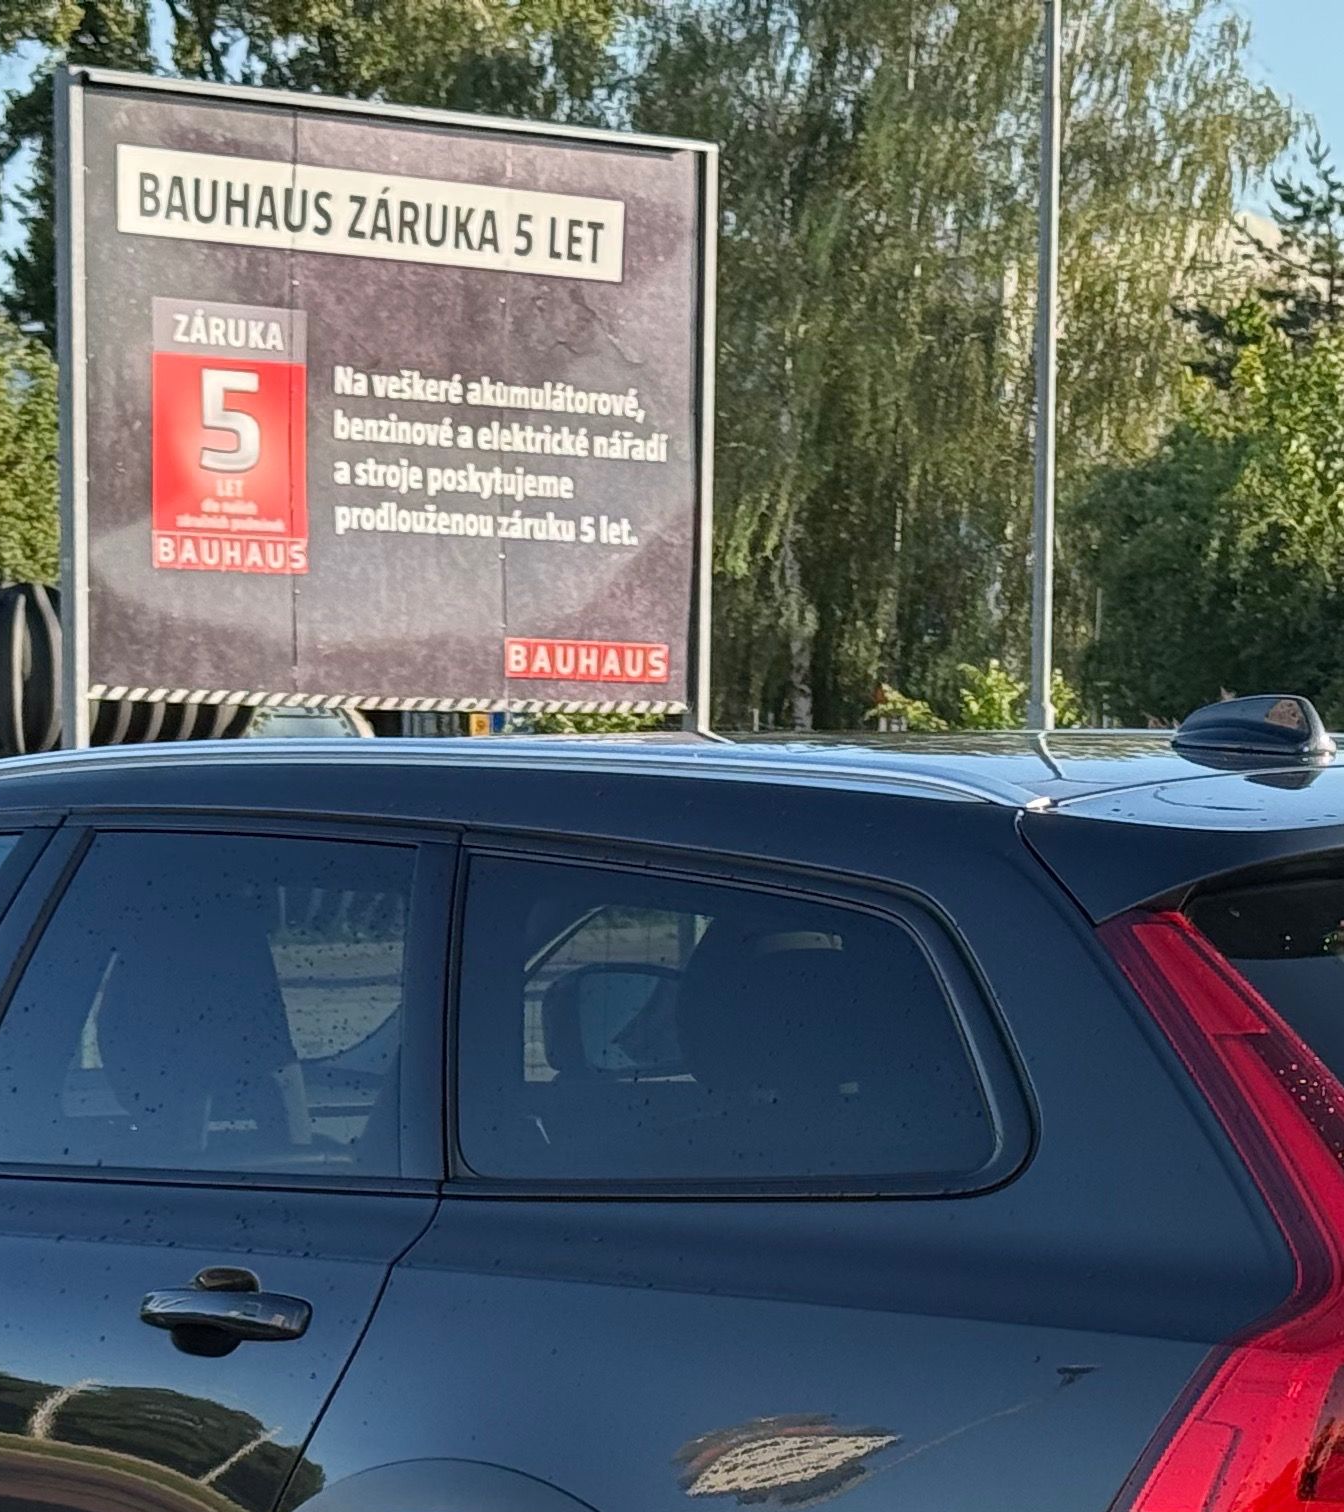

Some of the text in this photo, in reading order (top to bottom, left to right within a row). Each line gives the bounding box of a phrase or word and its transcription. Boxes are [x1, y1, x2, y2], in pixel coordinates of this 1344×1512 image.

[138, 171, 605, 264] BAUHAUS ZÁRUKA 5 LET
[173, 309, 285, 351] ZÁRUKA
[334, 366, 646, 424] Na veškeré akumulátorové,
[199, 368, 262, 473] 5
[334, 409, 669, 463] benzinové a elektrické nářadí
[333, 458, 574, 502] a stroje poskytujeme
[334, 502, 639, 546] prodlouženou záruku 5 let.
[158, 536, 307, 570] BAUHAUS
[508, 643, 669, 678] BAUHAUS
